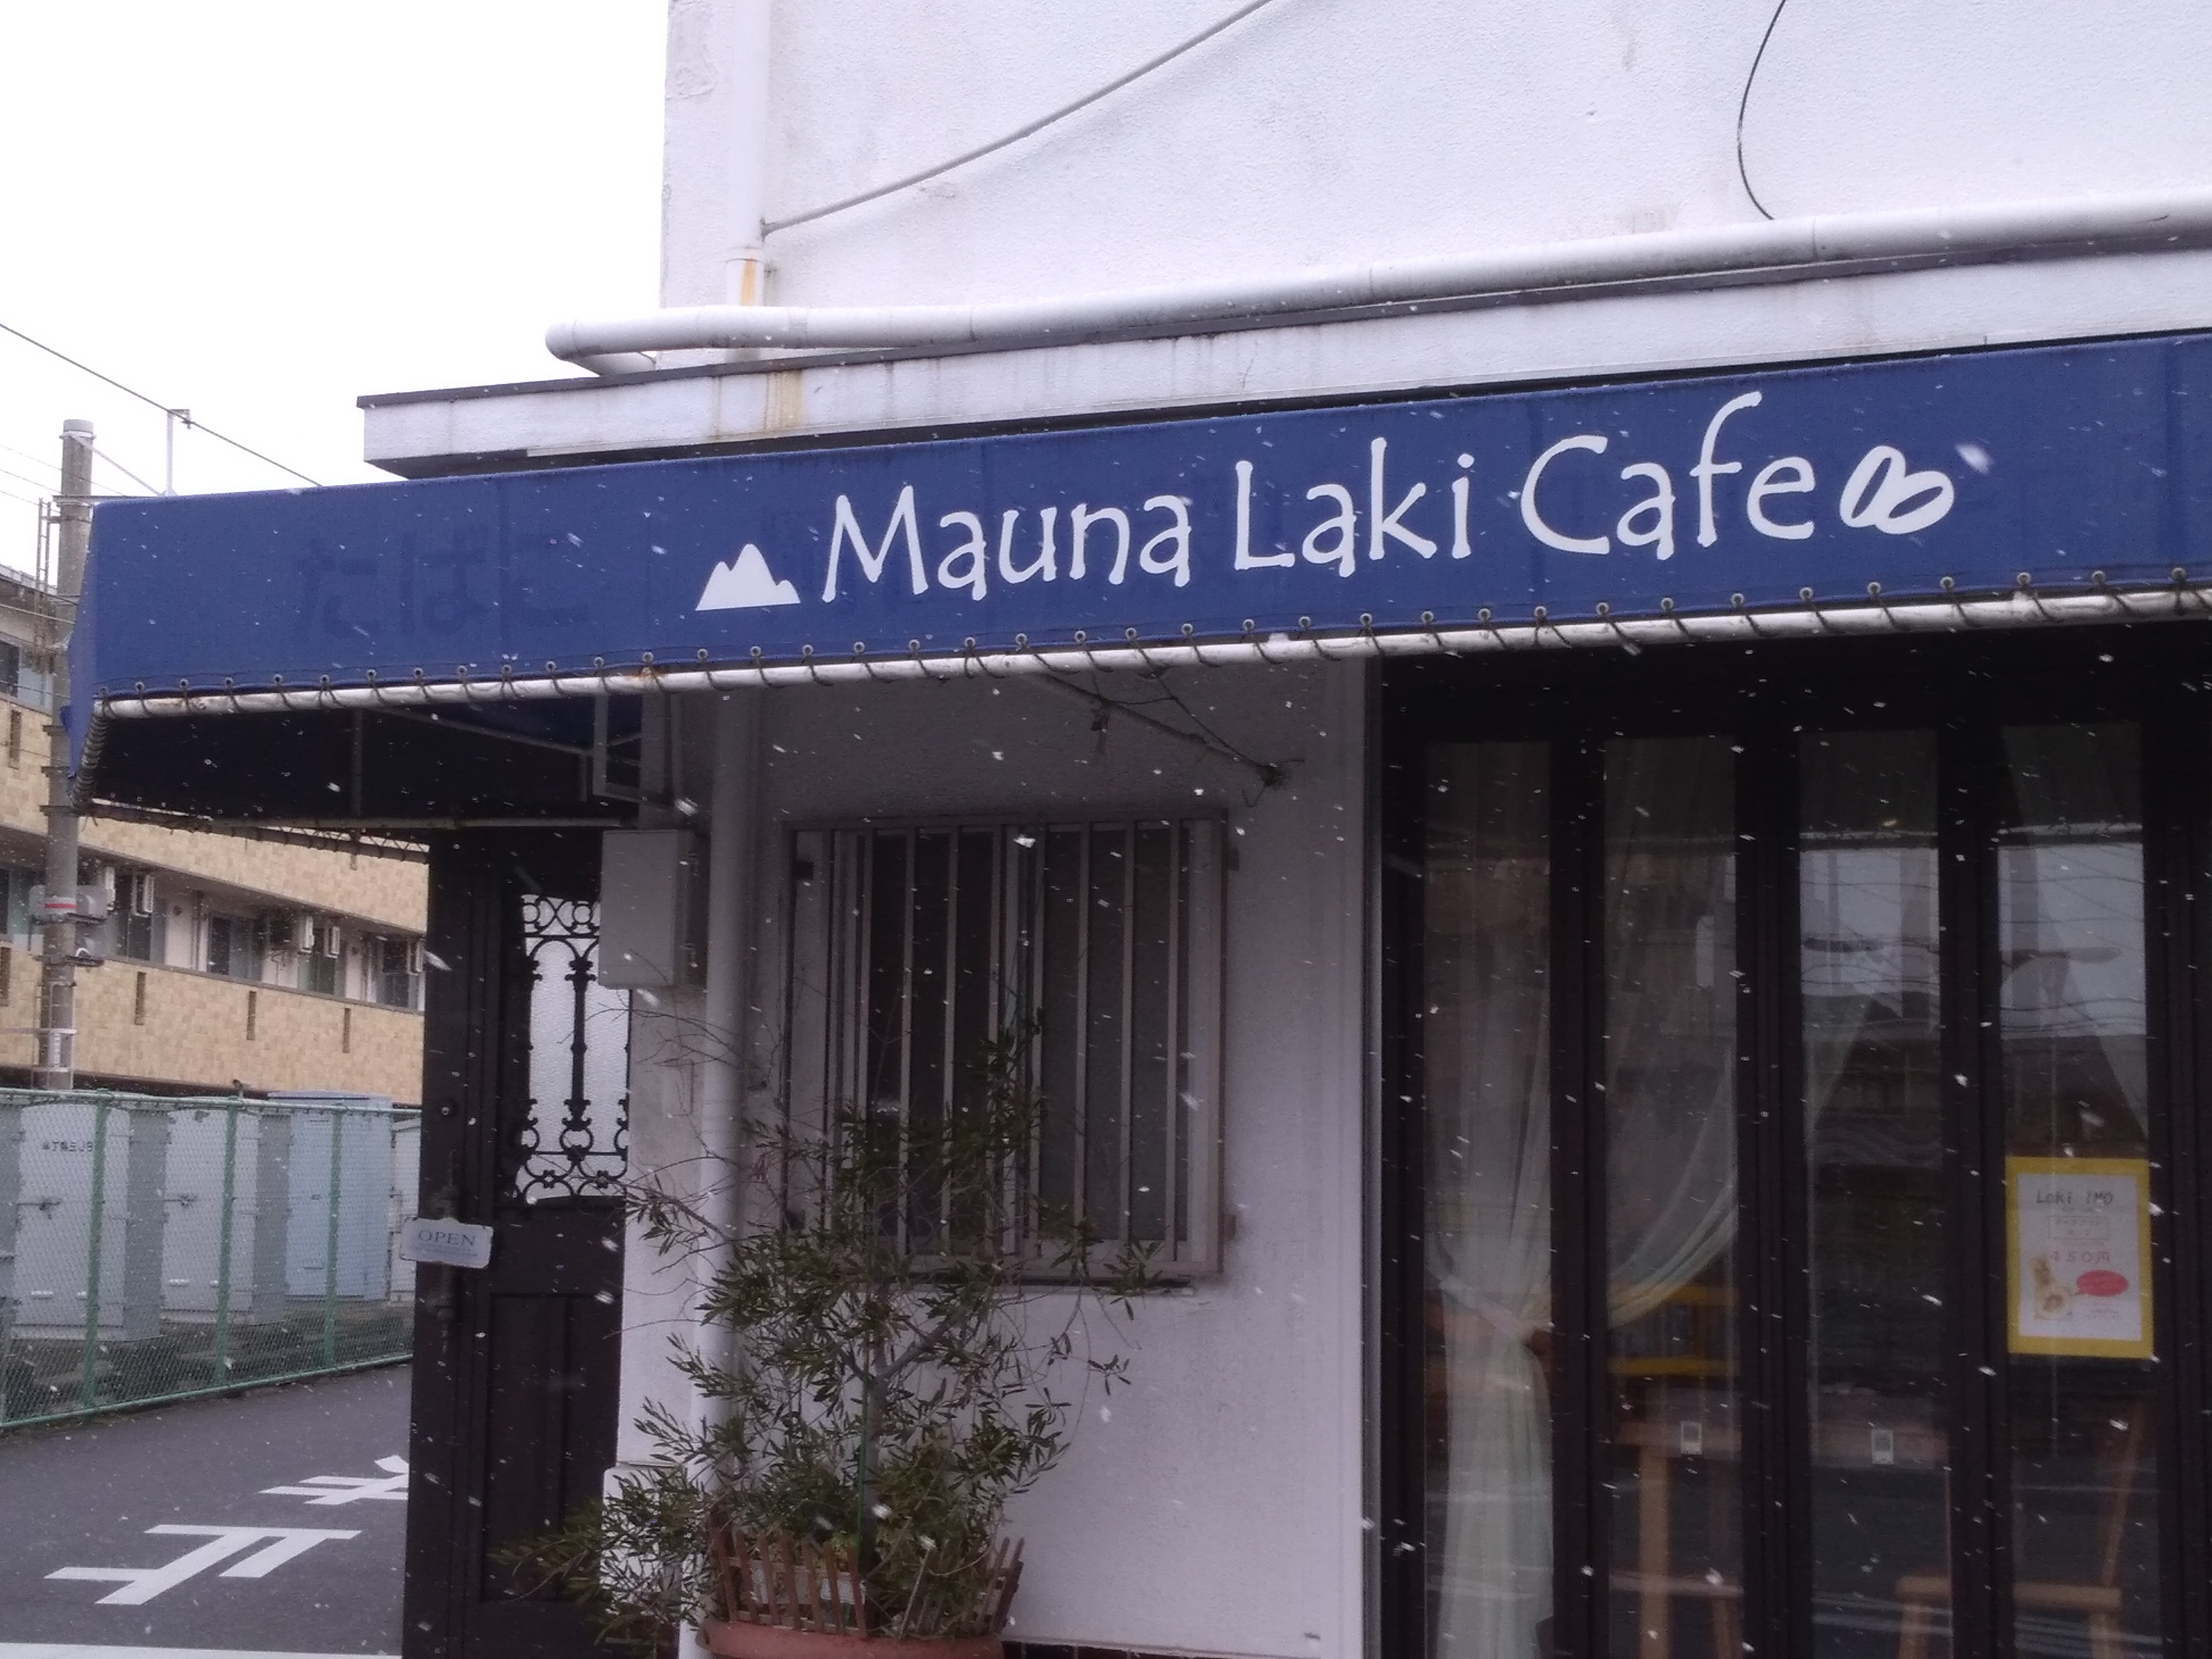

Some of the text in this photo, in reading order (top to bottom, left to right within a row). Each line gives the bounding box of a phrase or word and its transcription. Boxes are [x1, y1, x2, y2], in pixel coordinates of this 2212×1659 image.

[822, 391, 1815, 602] Mauna Laki Cafe
[418, 1229, 476, 1246] OPEN
